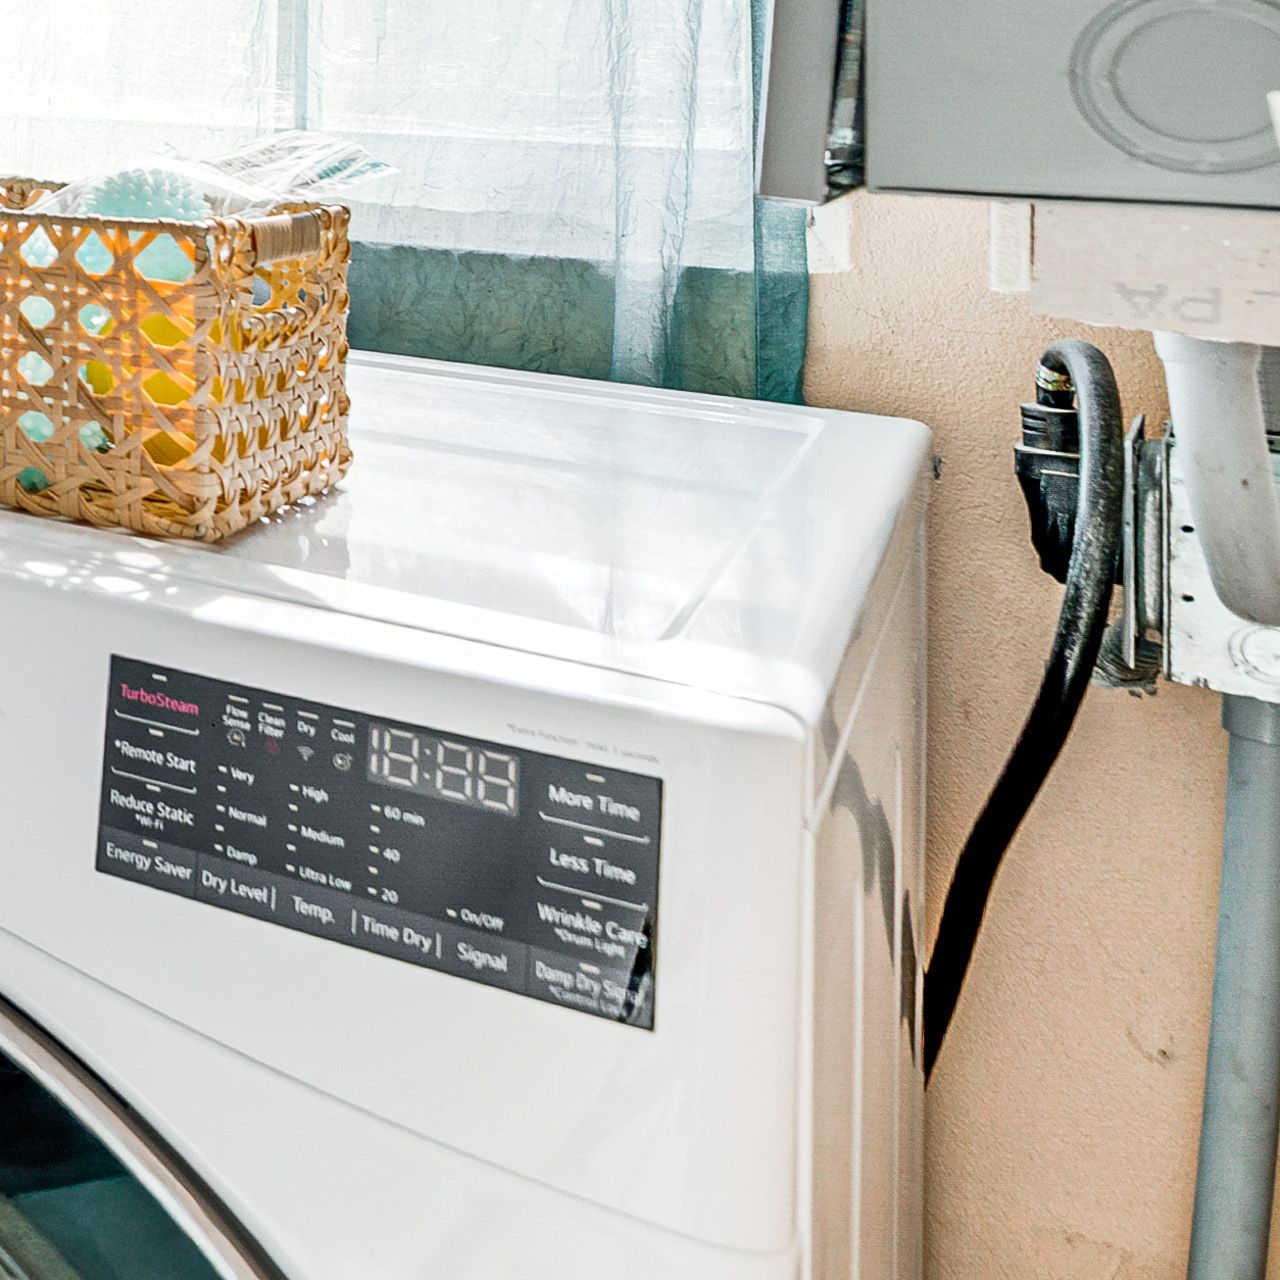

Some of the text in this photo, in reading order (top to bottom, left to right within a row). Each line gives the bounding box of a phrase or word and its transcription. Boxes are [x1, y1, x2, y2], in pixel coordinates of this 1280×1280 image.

[120, 683, 200, 716] TurboSteam
[258, 711, 286, 728] Clean
[258, 722, 284, 738] Filter
[297, 720, 316, 737] Dry
[330, 728, 355, 744] Cool
[166, 751, 197, 773] Start
[231, 767, 254, 785] Very
[302, 785, 329, 803] High
[549, 784, 640, 821] More Time
[110, 789, 194, 826] Reduce Static
[229, 807, 267, 827] Normal
[383, 805, 425, 827] 60 min
[300, 825, 345, 848] Medium
[106, 842, 193, 881] Energy Saver
[227, 845, 258, 866] Damp
[383, 848, 401, 863] 40
[549, 848, 637, 885] Less Time
[202, 870, 268, 904] Dry Level
[299, 866, 352, 891] Ultra Low
[381, 887, 399, 904] 20
[291, 895, 335, 925] Temp.
[460, 908, 504, 931] On/Off
[362, 914, 432, 953] Time Dry
[537, 901, 648, 949] Wrinkle Care
[457, 942, 508, 972] Signal
[535, 960, 575, 990] Damp
[576, 971, 601, 1003] Dry
